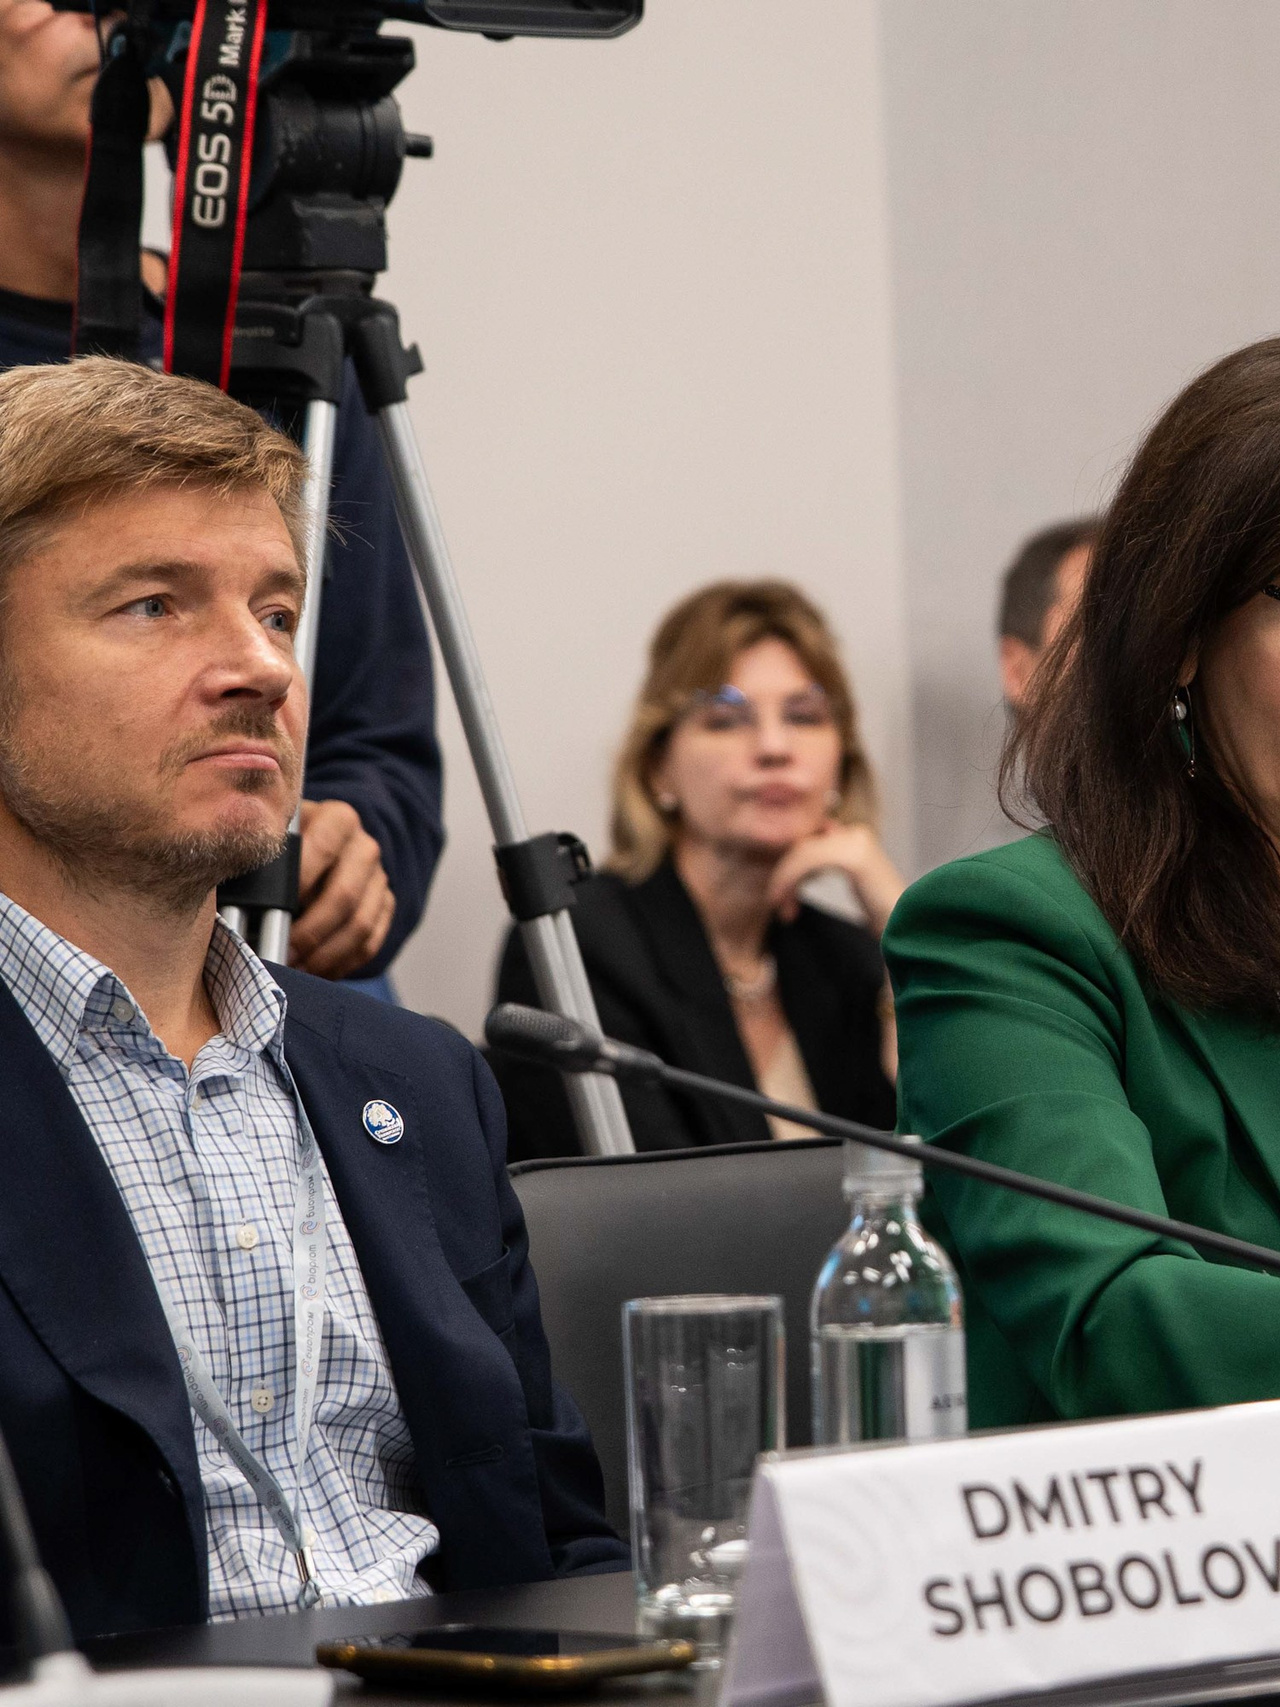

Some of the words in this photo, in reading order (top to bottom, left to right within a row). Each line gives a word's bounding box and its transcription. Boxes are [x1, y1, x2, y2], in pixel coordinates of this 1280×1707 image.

[218, 7, 247, 67] Mark
[201, 74, 237, 126] 5D
[192, 133, 231, 228] EOS
[308, 1243, 317, 1284] bioprom
[183, 1365, 209, 1411] bioprom
[961, 1459, 1204, 1540] DMITRY
